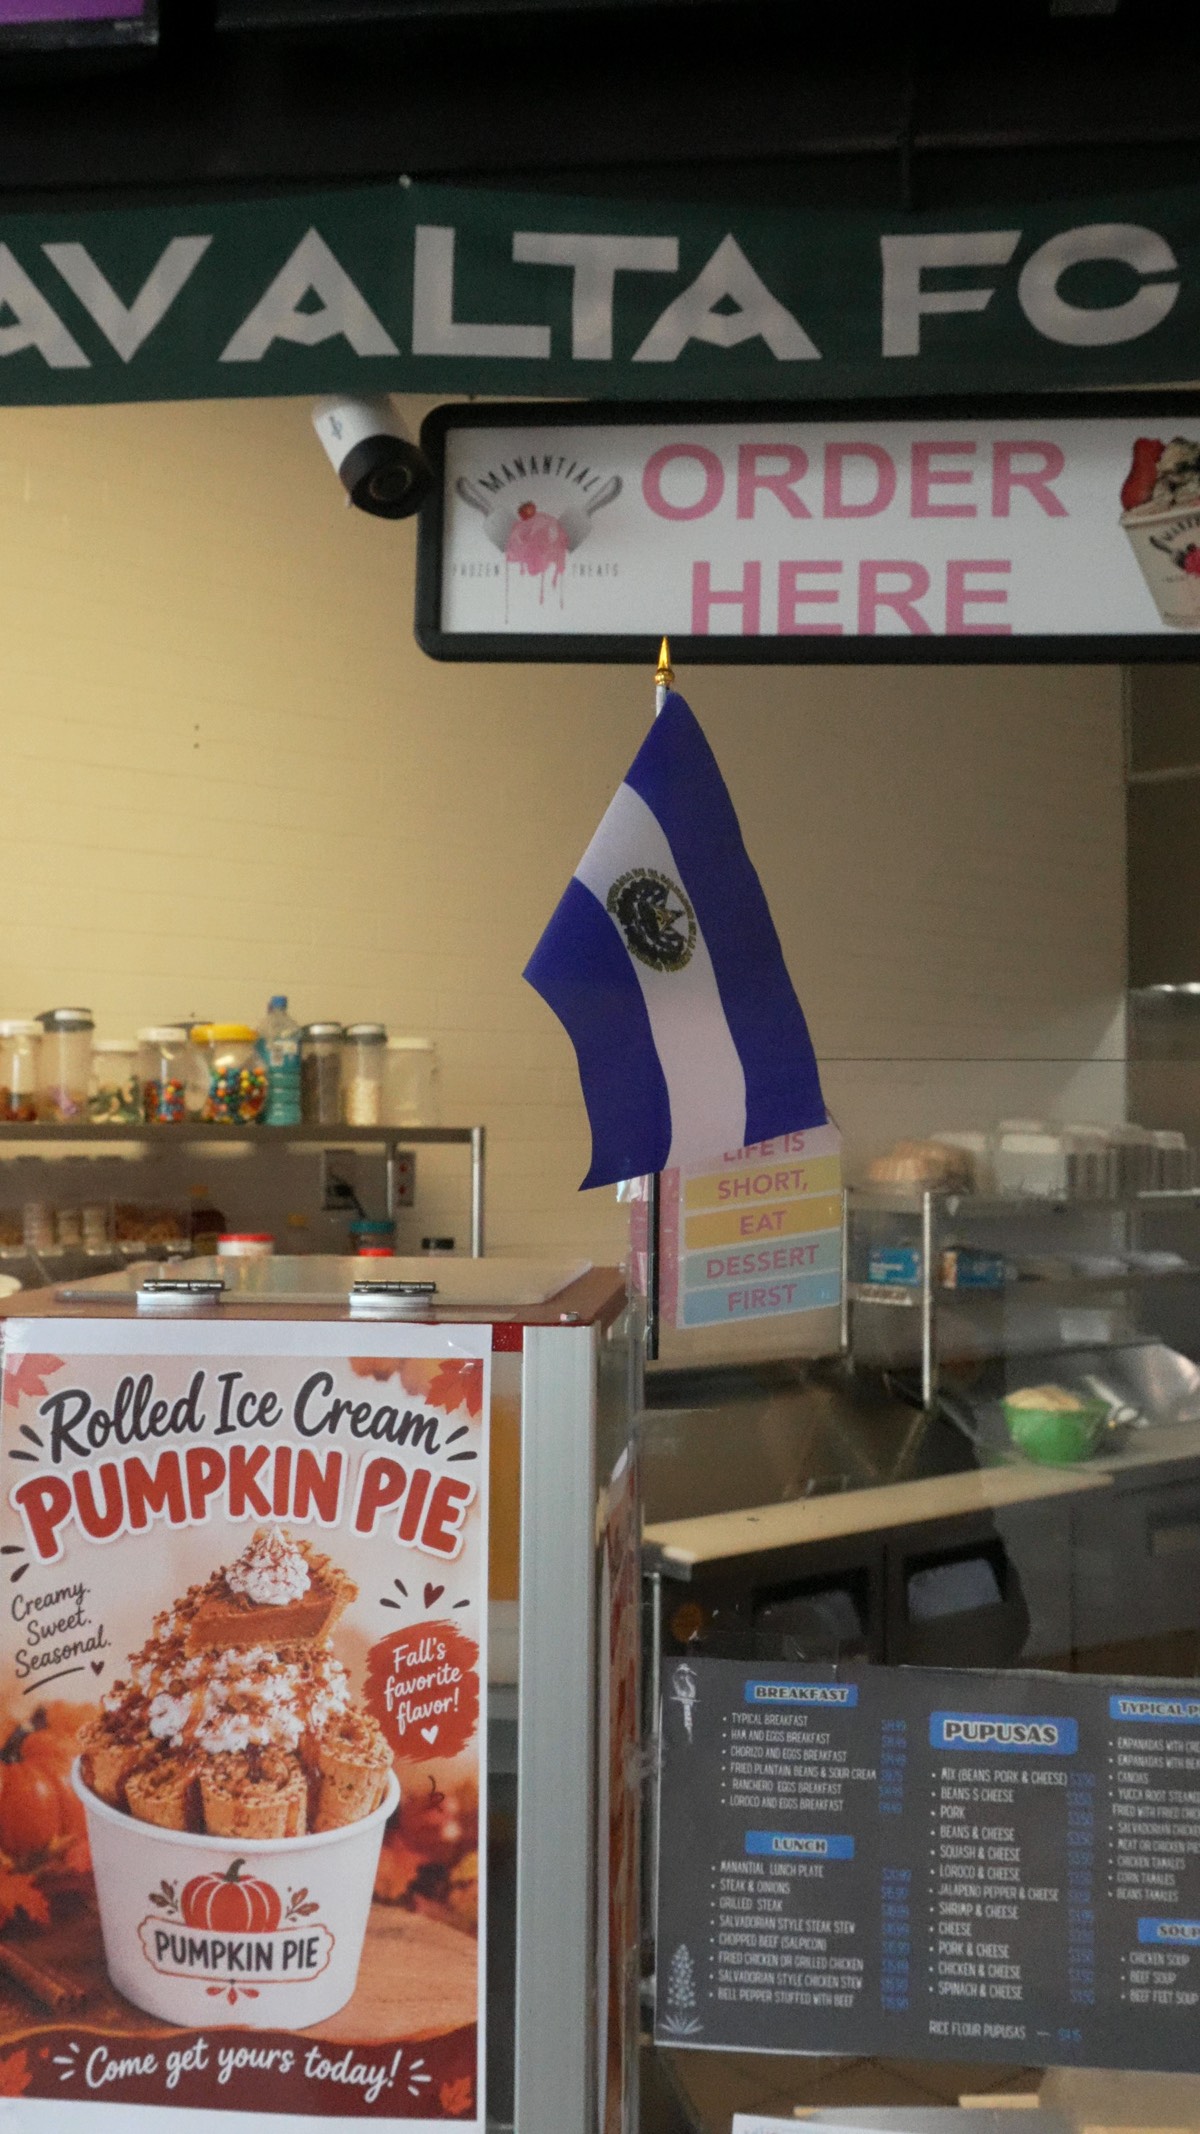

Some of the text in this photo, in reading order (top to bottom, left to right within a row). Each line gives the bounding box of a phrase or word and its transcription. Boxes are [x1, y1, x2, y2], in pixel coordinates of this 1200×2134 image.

[217, 224, 823, 363] ALTA
[880, 223, 1181, 357] FC
[478, 455, 600, 494] MANANTIAL
[641, 440, 1070, 522] ORDER
[691, 560, 1012, 635] HERE
[784, 1131, 805, 1153] IS
[718, 1169, 808, 1201] SHORT,
[739, 1210, 787, 1236] EAT
[706, 1244, 820, 1279] DESSERT
[727, 1284, 798, 1312] FIRST
[40, 1371, 440, 1463] Rolled Ice Cream
[15, 1445, 471, 1559] PUMPKIN PIE
[11, 1582, 91, 1622] Creamy.
[27, 1605, 92, 1646] Sweet.
[15, 1624, 112, 1679] Seasonal.
[392, 1637, 447, 1673] Fall's
[384, 1663, 463, 1712] favorite
[755, 1685, 848, 1702] BREAKFAST
[396, 1687, 460, 1736] flavor!
[1118, 1700, 1184, 1717] TYPICAL
[732, 1712, 808, 1727] TYPICAL BREAKFAST
[749, 1730, 765, 1742] AND
[786, 1732, 830, 1745] BREAKFAST
[943, 1719, 1059, 1746] PUPUSAS
[730, 1746, 764, 1759] CHORIZO
[765, 1748, 781, 1760] AND
[803, 1749, 847, 1763] BREAKFAST
[730, 1762, 753, 1775] FRIED
[732, 1778, 774, 1792] RANCHERO
[798, 1781, 842, 1795] BREAKFAST
[940, 1786, 970, 1801] BEANS
[981, 1788, 1015, 1803] CHEESE
[729, 1794, 760, 1808] LOROCO
[800, 1798, 844, 1812] BREAKFAST
[940, 1804, 966, 1819] PORK
[940, 1825, 1015, 1842] BEANS & CHEESE
[772, 1837, 827, 1853] LUNCH
[940, 1844, 1020, 1862] SQUASH & CHEESE
[769, 1863, 796, 1877] LUNCH
[798, 1864, 824, 1878] PLATE
[939, 1863, 1020, 1882] LOROCO & CHEESE
[720, 1878, 745, 1892] STEAK
[1027, 1887, 1059, 1902] CHEESE
[757, 1897, 783, 1912] STEAK
[938, 1901, 1019, 1920] SHRIMP & CHEESE
[938, 1921, 972, 1937] CHEESE
[154, 1930, 319, 1972] PUMPKIN PIE
[938, 1940, 1010, 1959] PORK & CHEESE
[938, 1961, 1021, 1980] CHICKEN & CHEESE
[938, 1981, 1023, 2001] SPINACH & CHEESE
[929, 2020, 1027, 2040] RICE FLOUR PUPUSAS
[86, 2038, 402, 2103] Come get yours today!
